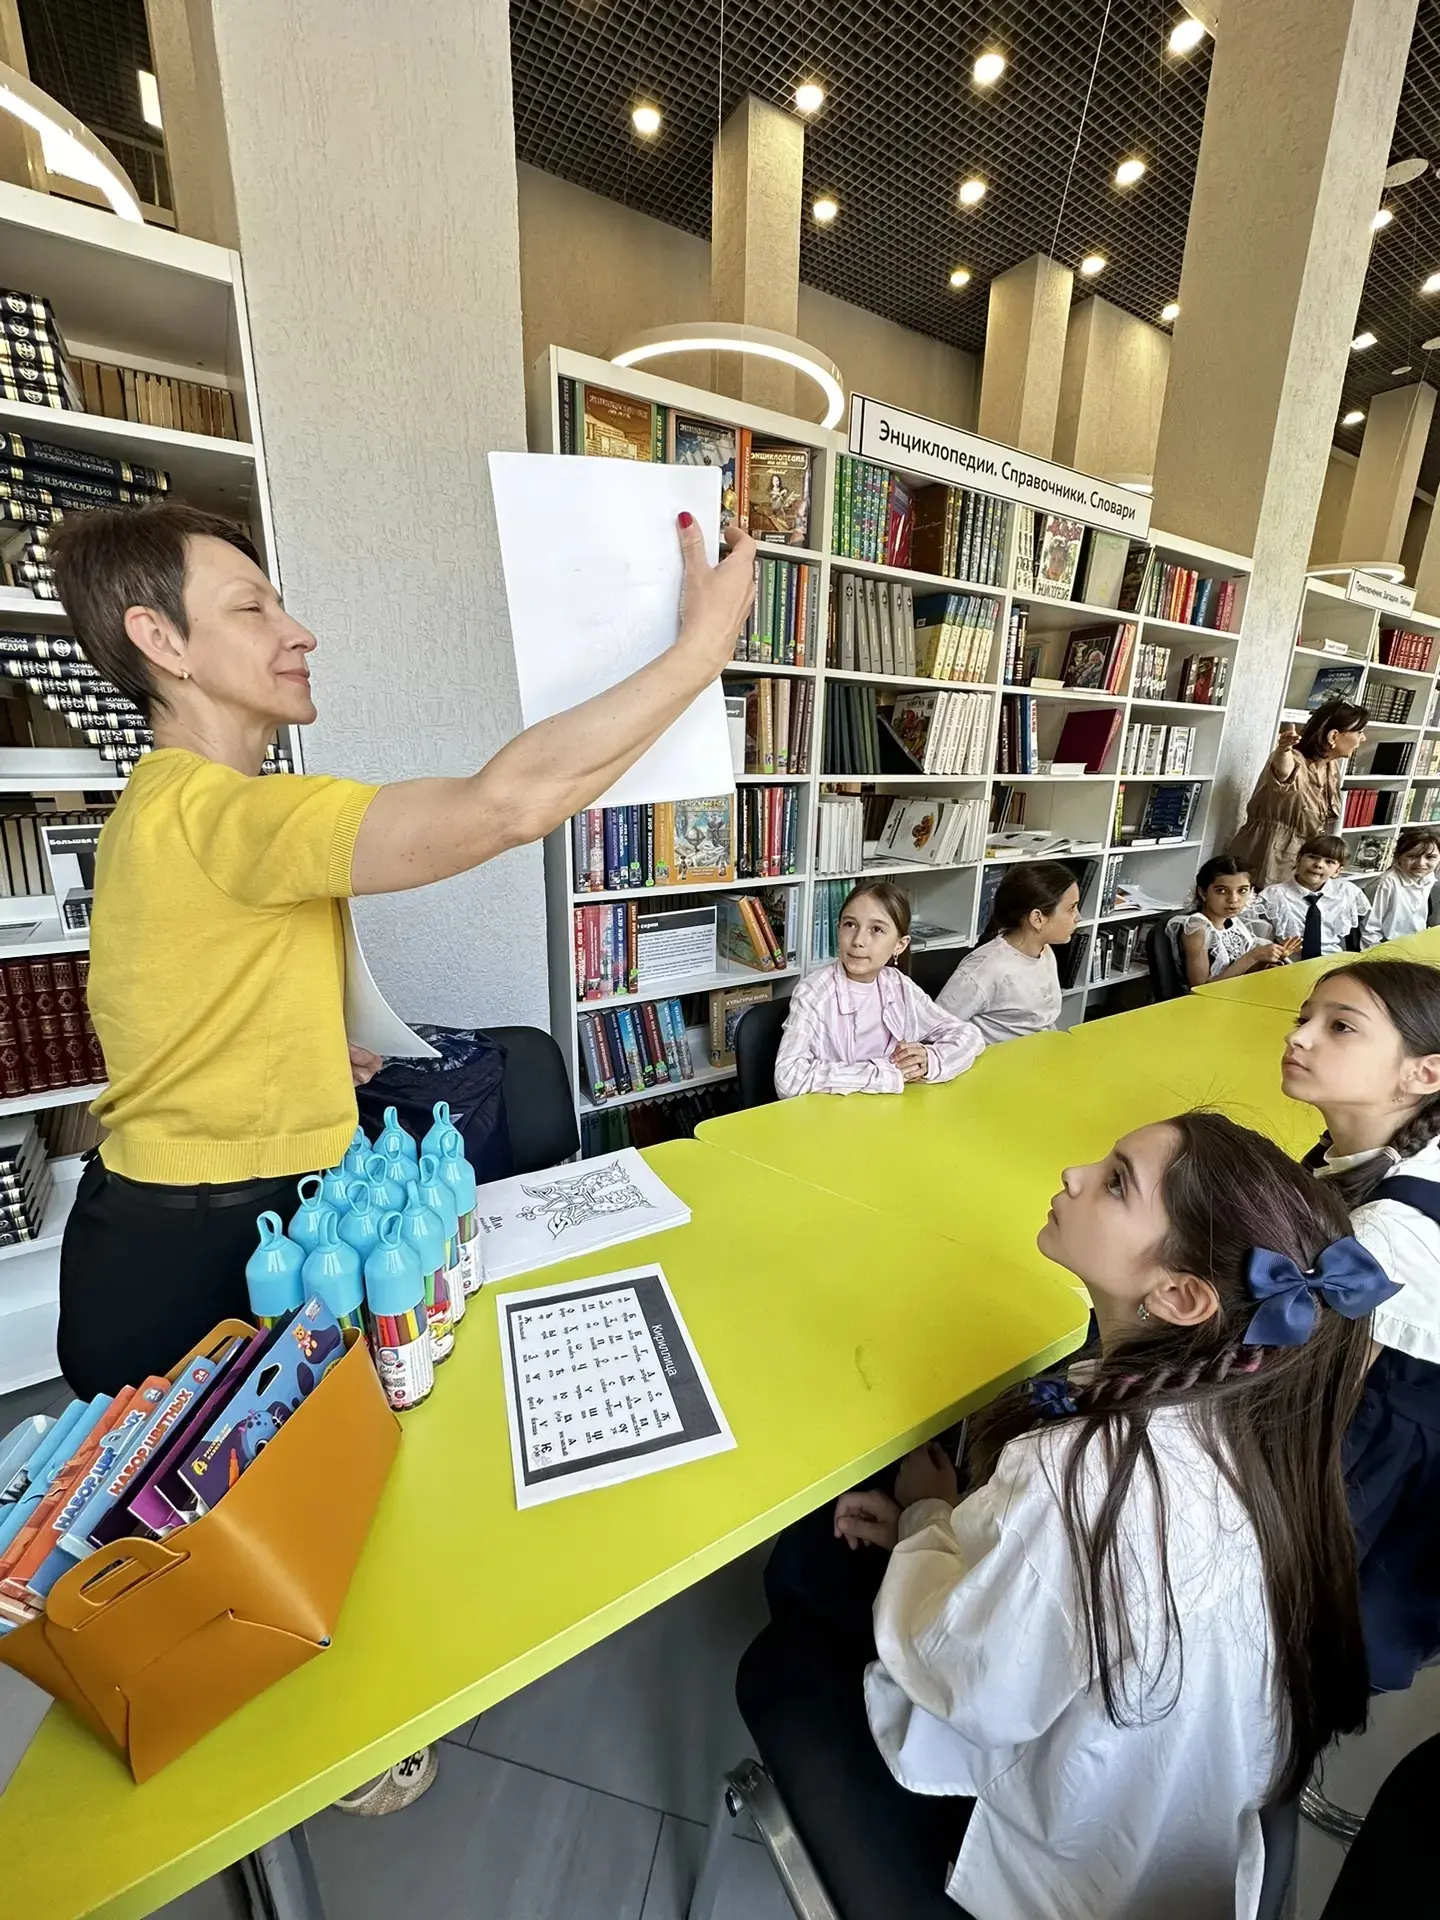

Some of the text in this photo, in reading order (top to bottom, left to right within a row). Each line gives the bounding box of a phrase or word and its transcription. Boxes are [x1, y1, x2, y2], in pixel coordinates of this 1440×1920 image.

[878, 419, 1136, 521] Энциклопедии. Справочники. Словари
[35, 662, 48, 674] 22
[55, 680, 68, 691] 22
[72, 697, 84, 709] 23
[93, 715, 105, 726] 23
[49, 838, 92, 846] Большая
[652, 1324, 678, 1377] Кириллица
[196, 1370, 206, 1383] 24
[147, 1388, 158, 1400] 24
[613, 1401, 622, 1409] Т
[589, 1407, 598, 1417] Ш
[108, 1388, 193, 1497] НАБОР ЦВЕТНЫХ
[53, 1475, 98, 1530] НАБОР
